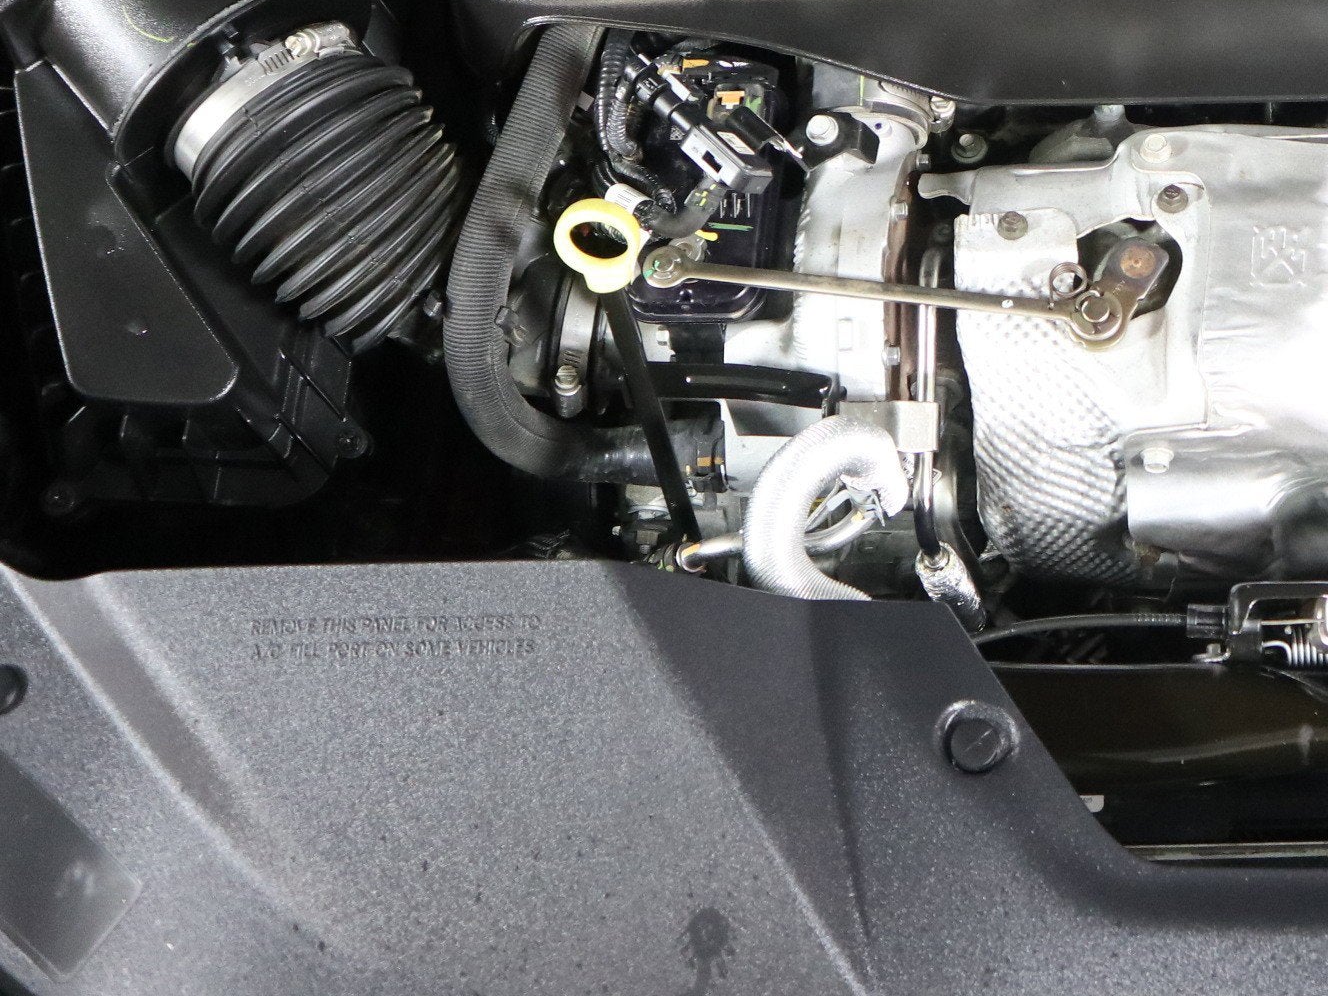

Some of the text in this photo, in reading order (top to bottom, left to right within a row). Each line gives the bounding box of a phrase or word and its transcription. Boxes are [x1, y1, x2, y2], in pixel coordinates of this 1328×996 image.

[250, 616, 317, 636] REMOVE
[321, 616, 357, 635] THIS
[360, 615, 411, 634] PANEL
[417, 614, 448, 633] FOR
[520, 613, 541, 631] TO
[328, 641, 370, 659] PORT
[374, 640, 400, 658] ON
[404, 639, 451, 658] SOME
[455, 637, 536, 657] VEHICLES
